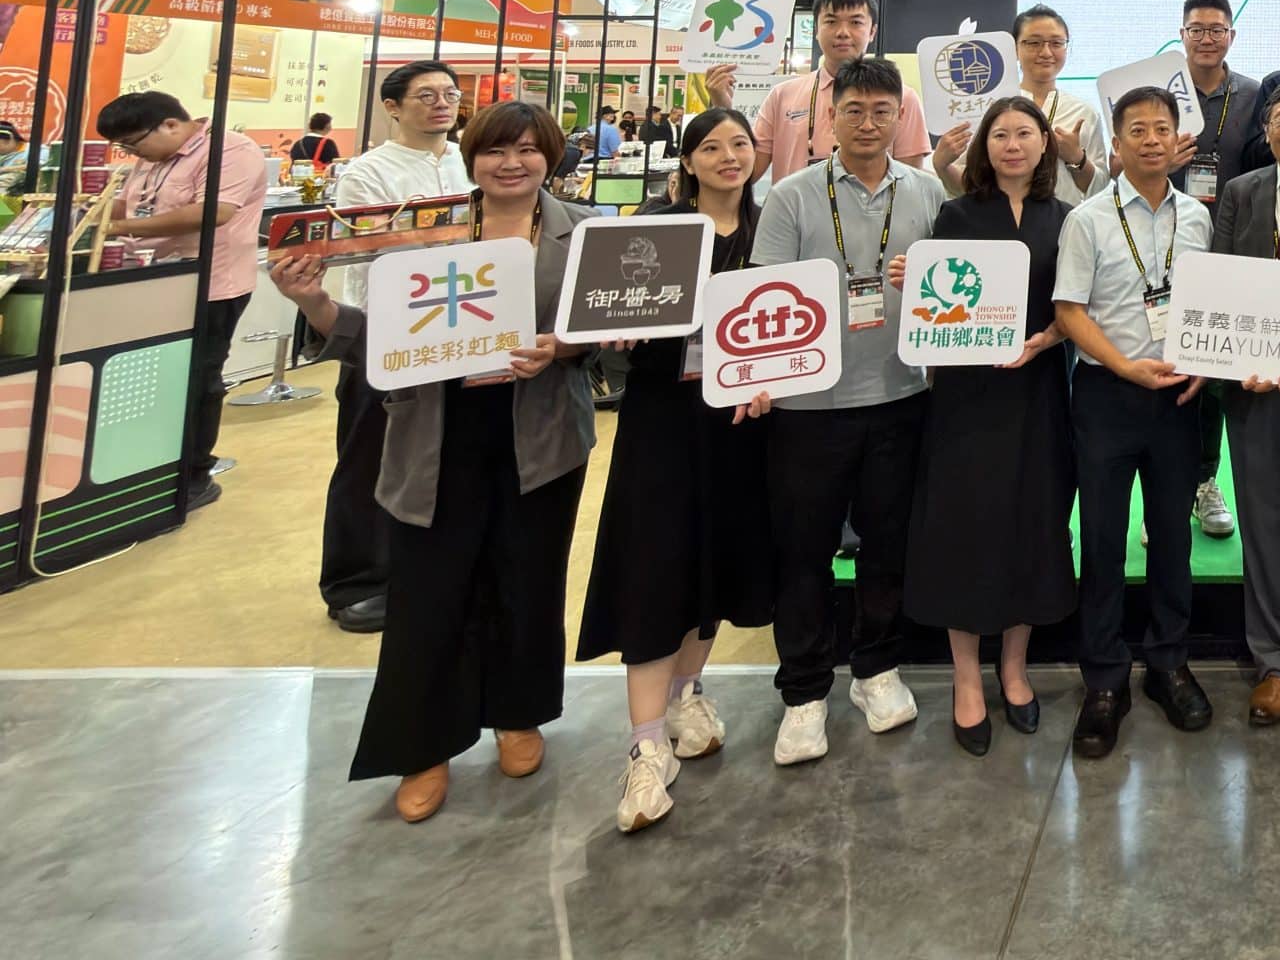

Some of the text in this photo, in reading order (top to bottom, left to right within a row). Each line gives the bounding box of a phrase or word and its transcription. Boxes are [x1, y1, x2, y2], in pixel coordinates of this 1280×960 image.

[511, 33, 533, 43] FOOD
[575, 39, 595, 48] FOODS
[596, 39, 625, 49] INUSTRY,
[975, 312, 1017, 321] TOWNSHIP
[908, 325, 1016, 349] 中埔鄉農會
